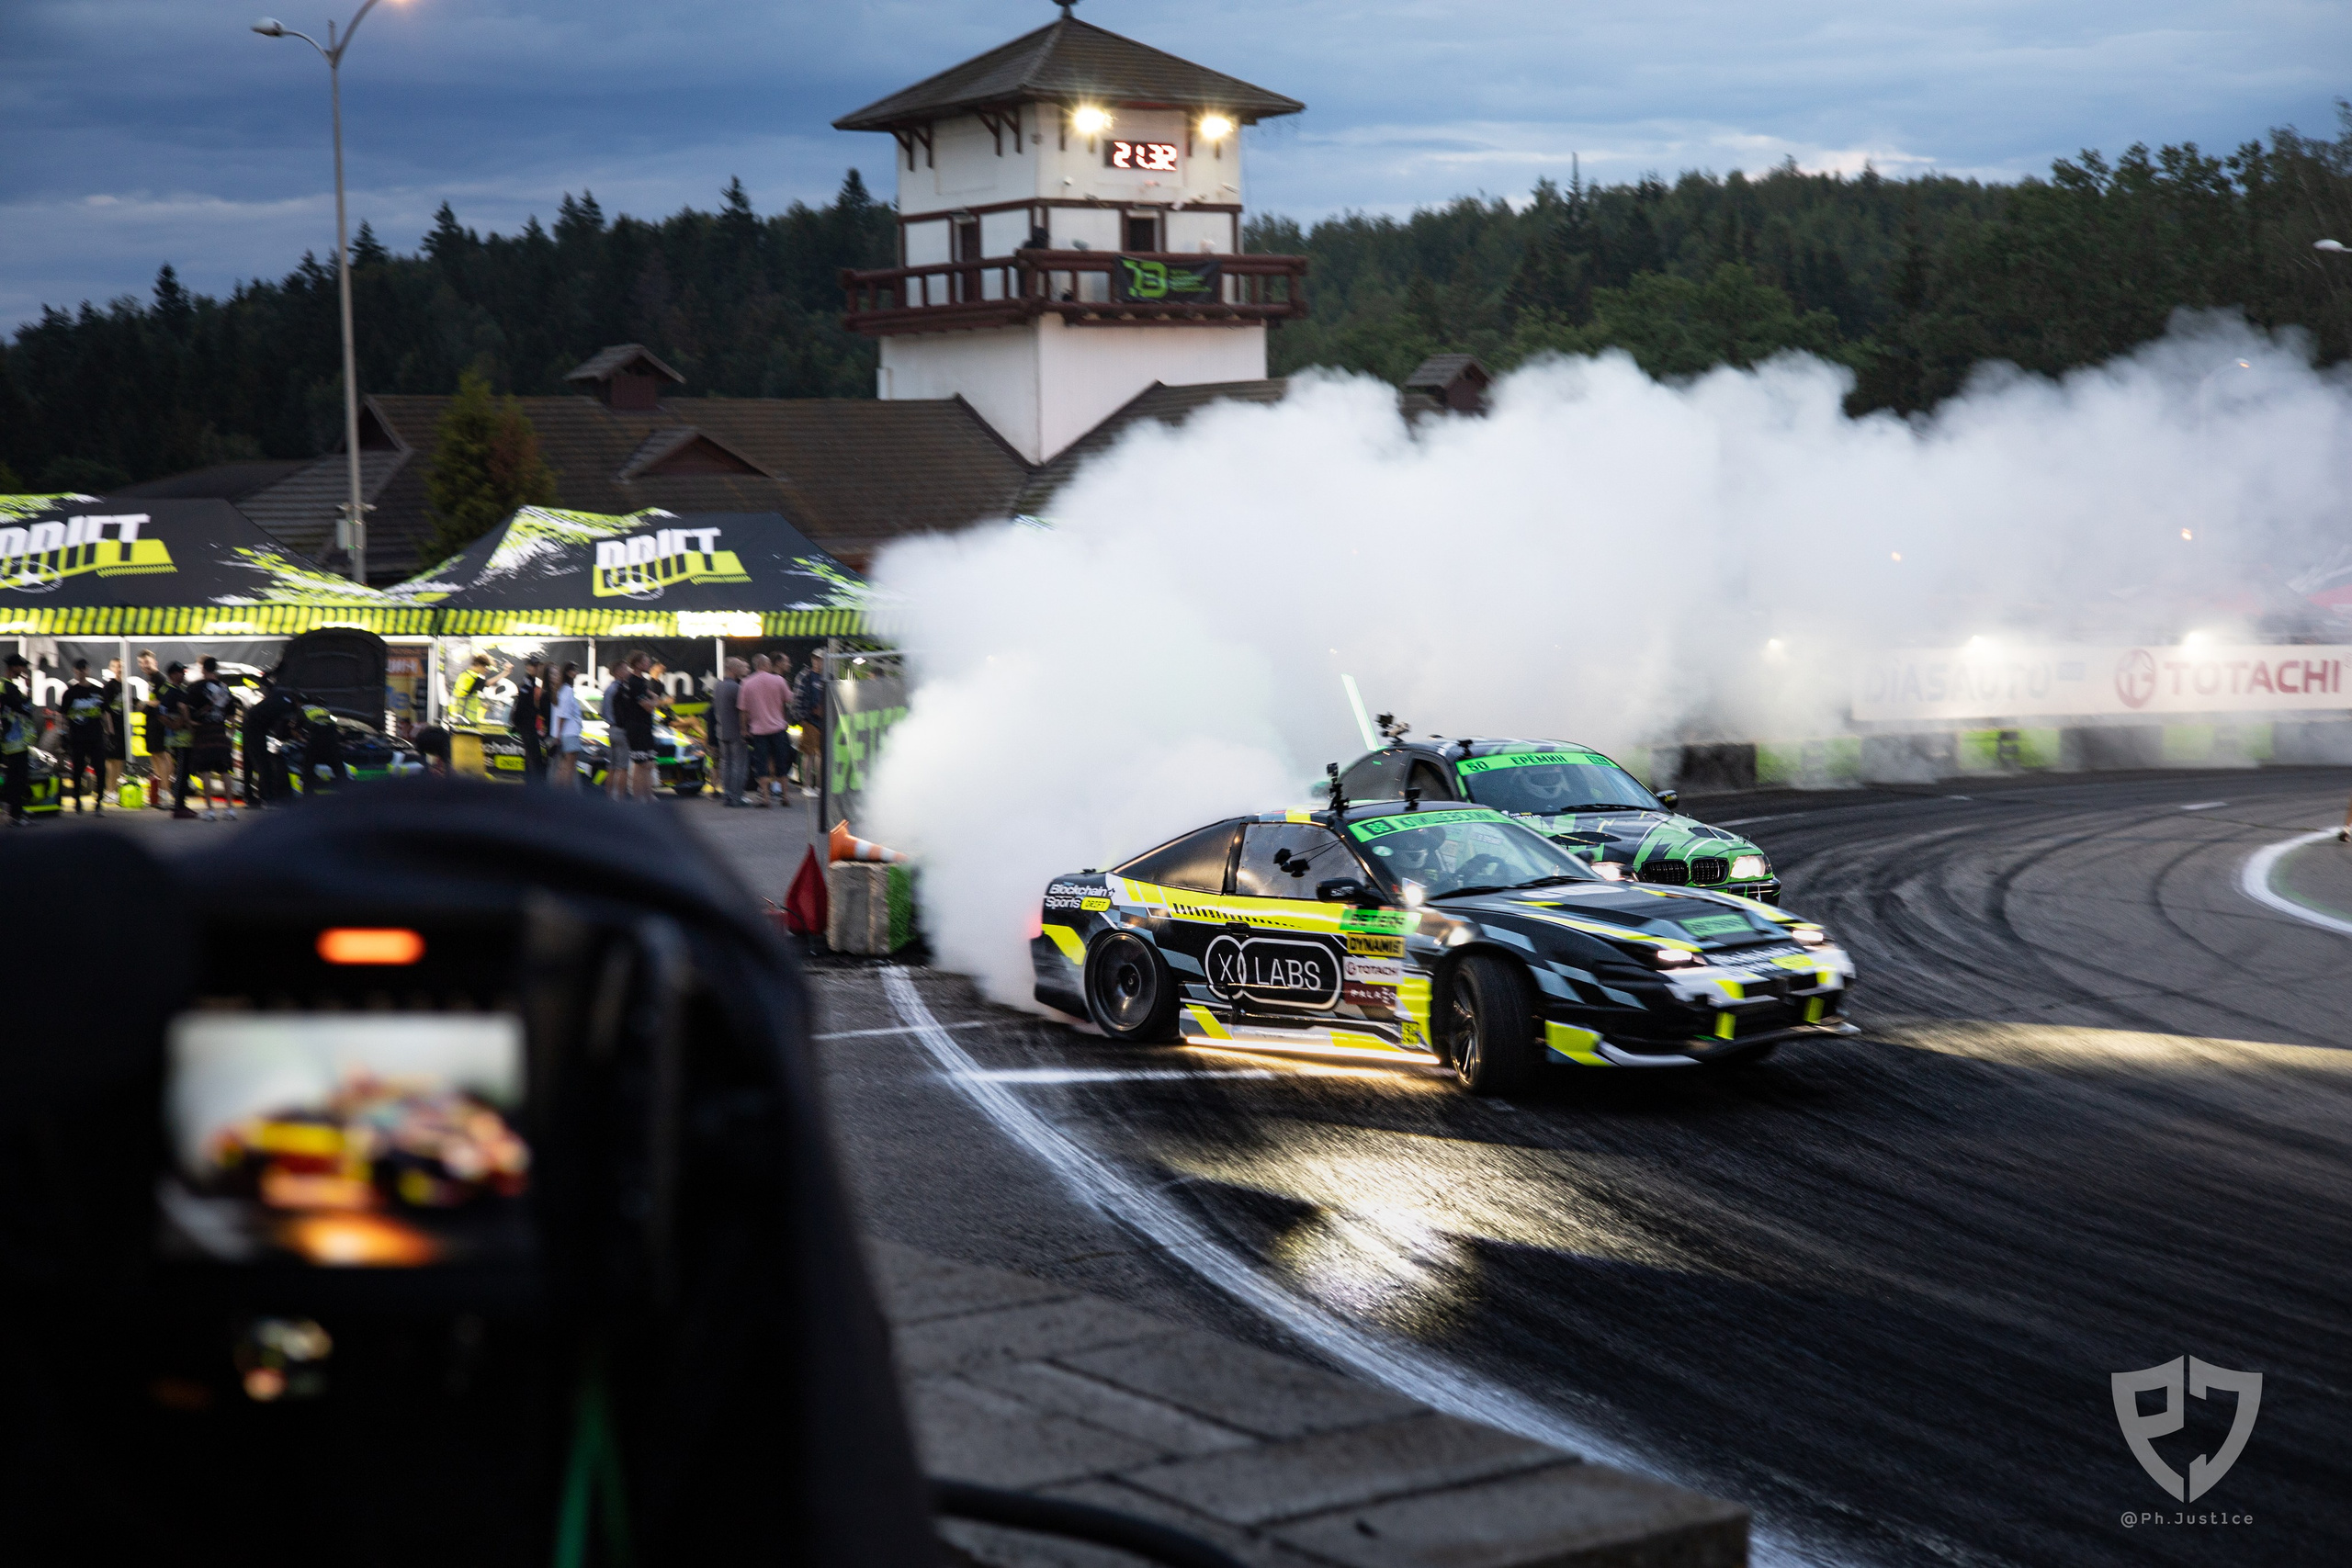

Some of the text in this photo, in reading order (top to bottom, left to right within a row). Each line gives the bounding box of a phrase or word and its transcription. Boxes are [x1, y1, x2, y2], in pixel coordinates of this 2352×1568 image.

[595, 526, 721, 570] DRIFT
[2163, 659, 2342, 695] TOTACHI
[1045, 896, 1082, 909] Sports
[1049, 884, 1107, 897] Blockchain
[1217, 953, 1322, 991] X LABS
